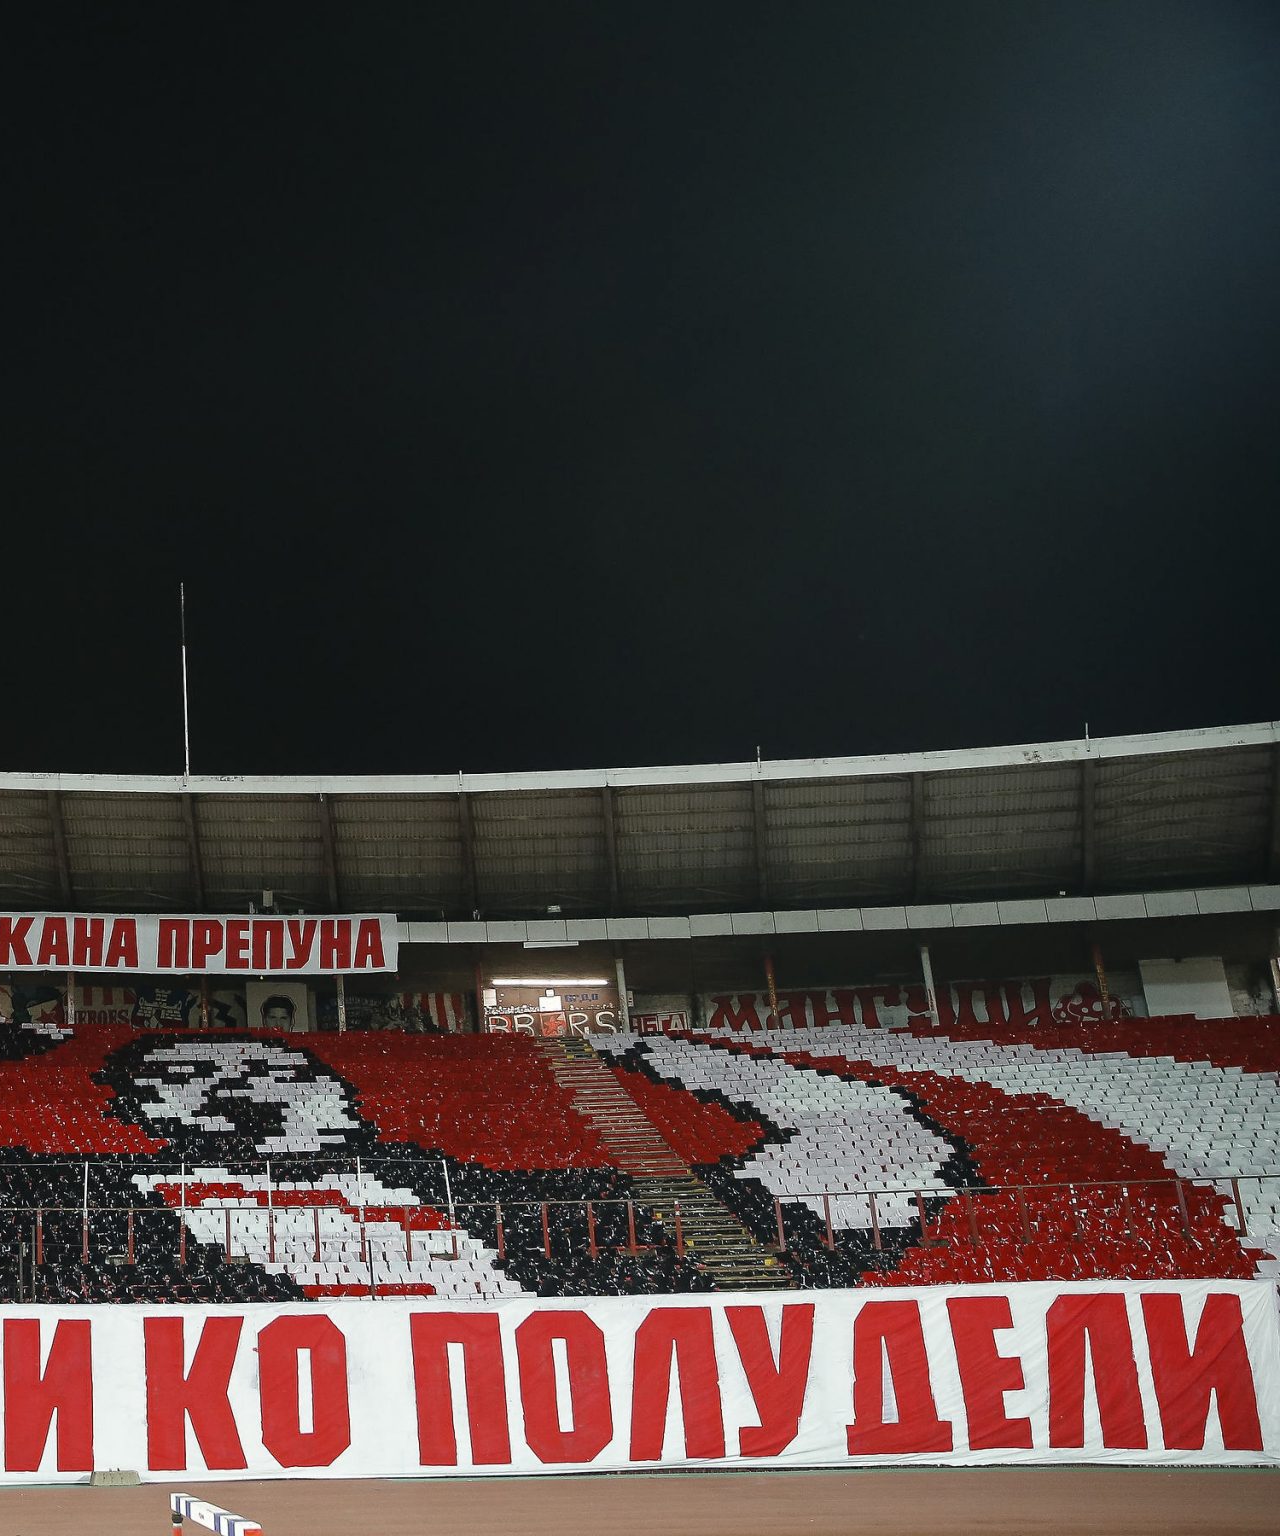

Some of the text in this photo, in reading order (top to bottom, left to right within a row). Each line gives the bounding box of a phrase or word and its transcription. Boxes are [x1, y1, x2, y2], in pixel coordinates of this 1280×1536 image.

[157, 918, 386, 969] ПРЕПУНА
[143, 1314, 352, 1472] КО
[408, 1292, 1264, 1467] ПОЛУДЕЛИ
